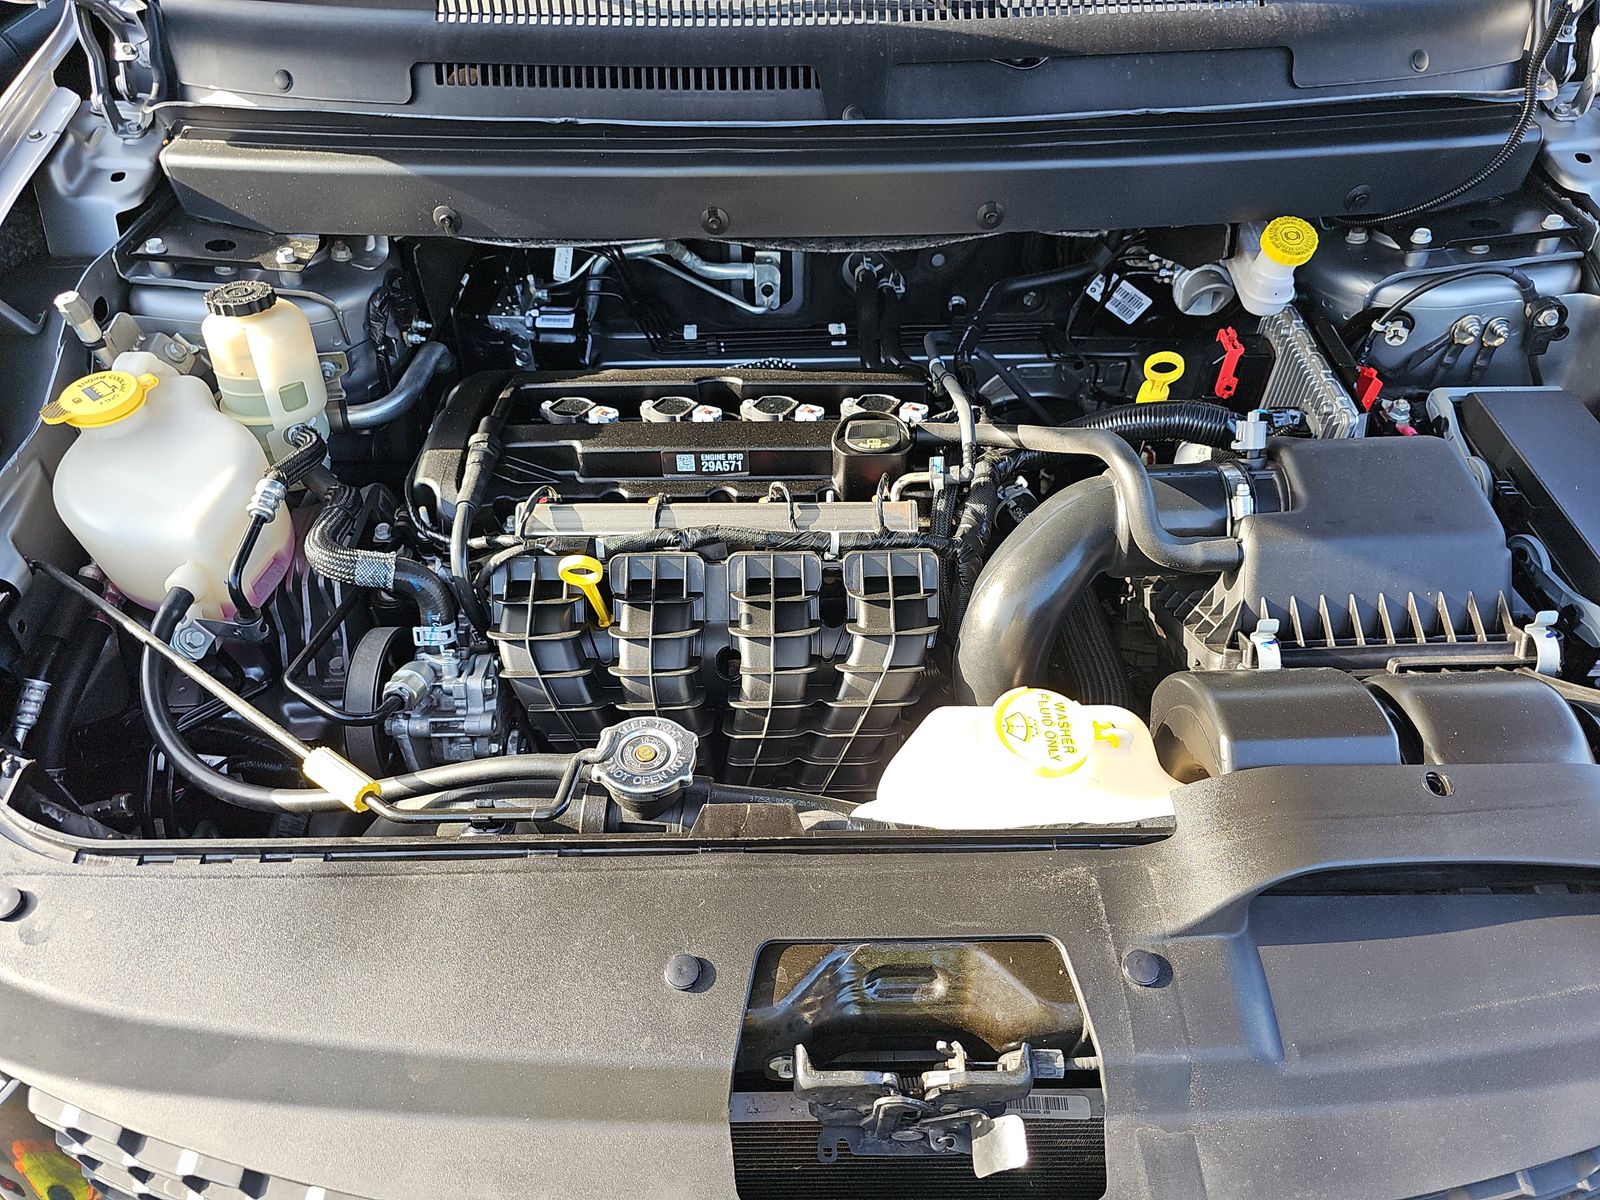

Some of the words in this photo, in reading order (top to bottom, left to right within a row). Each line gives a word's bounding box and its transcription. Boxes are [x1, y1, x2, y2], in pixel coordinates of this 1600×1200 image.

[700, 453, 726, 461] ENGINE
[701, 461, 742, 472] 29A571
[1038, 693, 1054, 727] FLUID
[654, 719, 685, 741] TIGHT
[1053, 702, 1078, 754] WASHER
[1044, 730, 1062, 762] ONLY
[606, 763, 632, 781] NOT
[632, 771, 669, 785] OPEN
[667, 753, 687, 774] HOT
